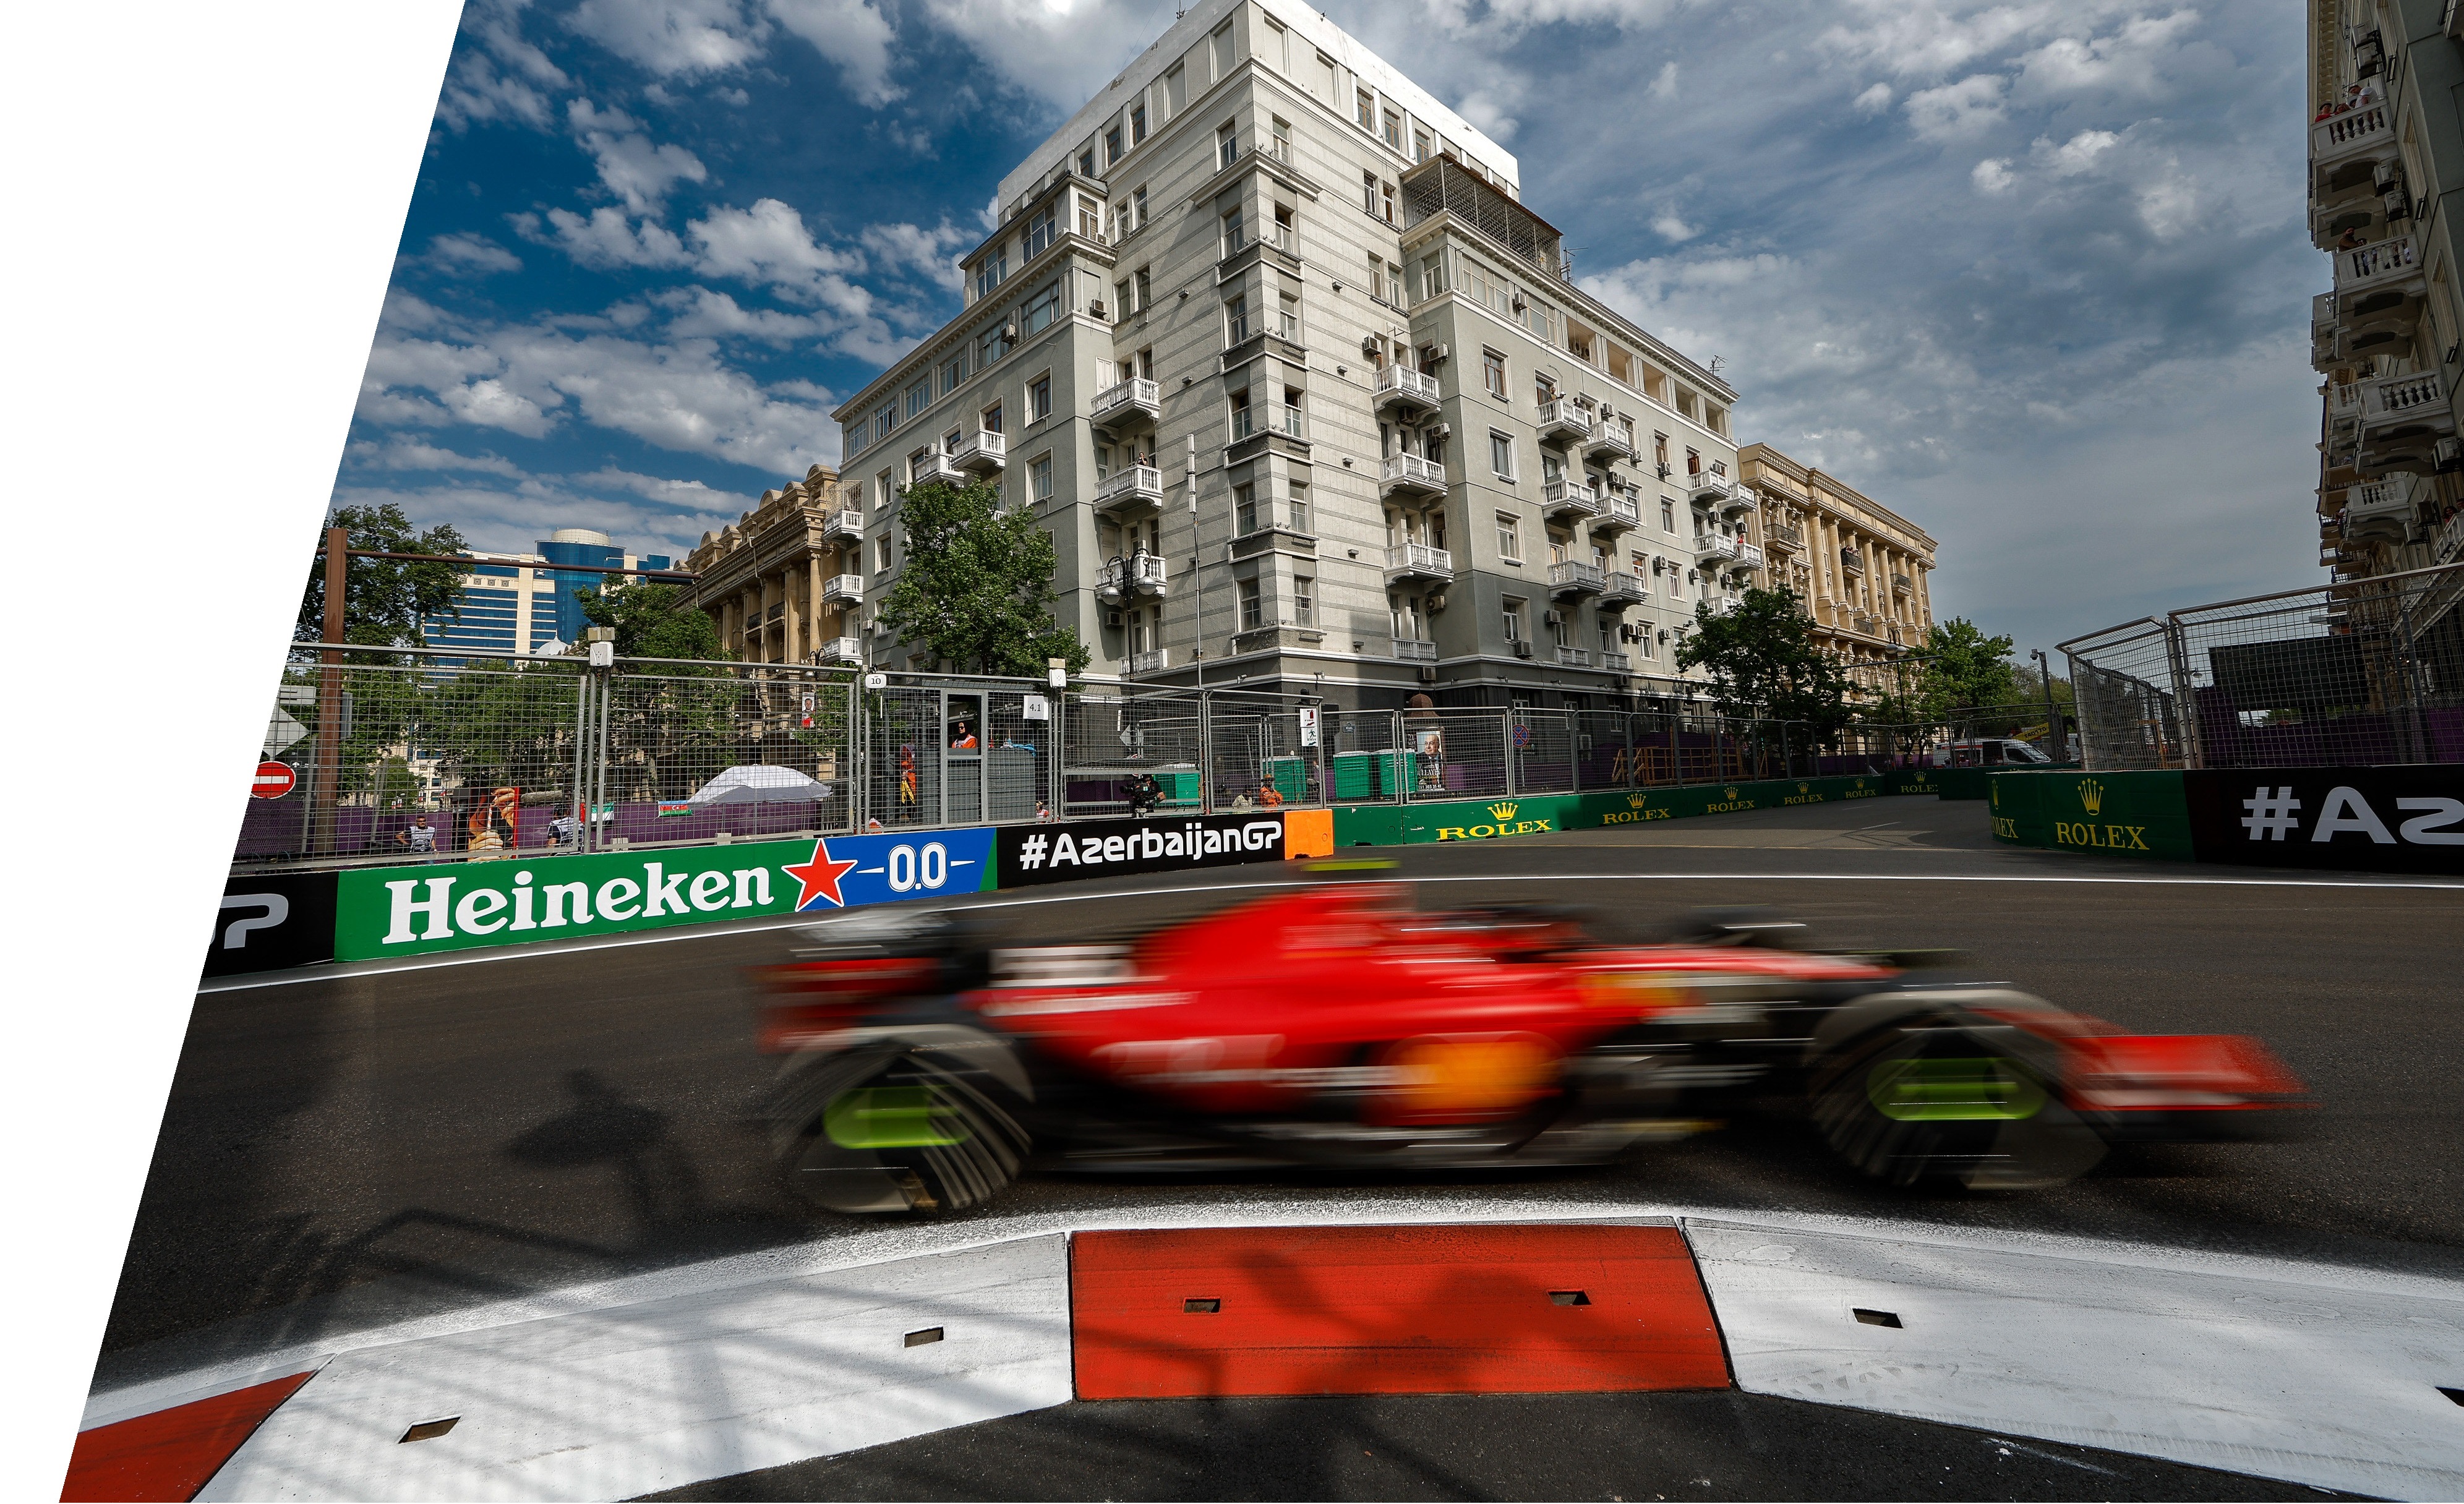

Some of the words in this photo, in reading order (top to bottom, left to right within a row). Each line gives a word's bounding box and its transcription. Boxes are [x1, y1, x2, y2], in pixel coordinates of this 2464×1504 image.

[1029, 703, 1041, 712] 4.1
[1846, 789, 1876, 799] ROLEX
[1901, 784, 1938, 793] ROLE
[1706, 800, 1755, 813] ROLEX
[1784, 793, 1824, 805] ROLEX
[1602, 808, 1670, 824] ROLEX
[1435, 819, 1552, 840] ROLEX
[2055, 822, 2150, 850] ROLEX
[1020, 821, 1281, 870] #AzerbaijanGP
[382, 862, 775, 944] Heineken
[210, 893, 289, 949] P
